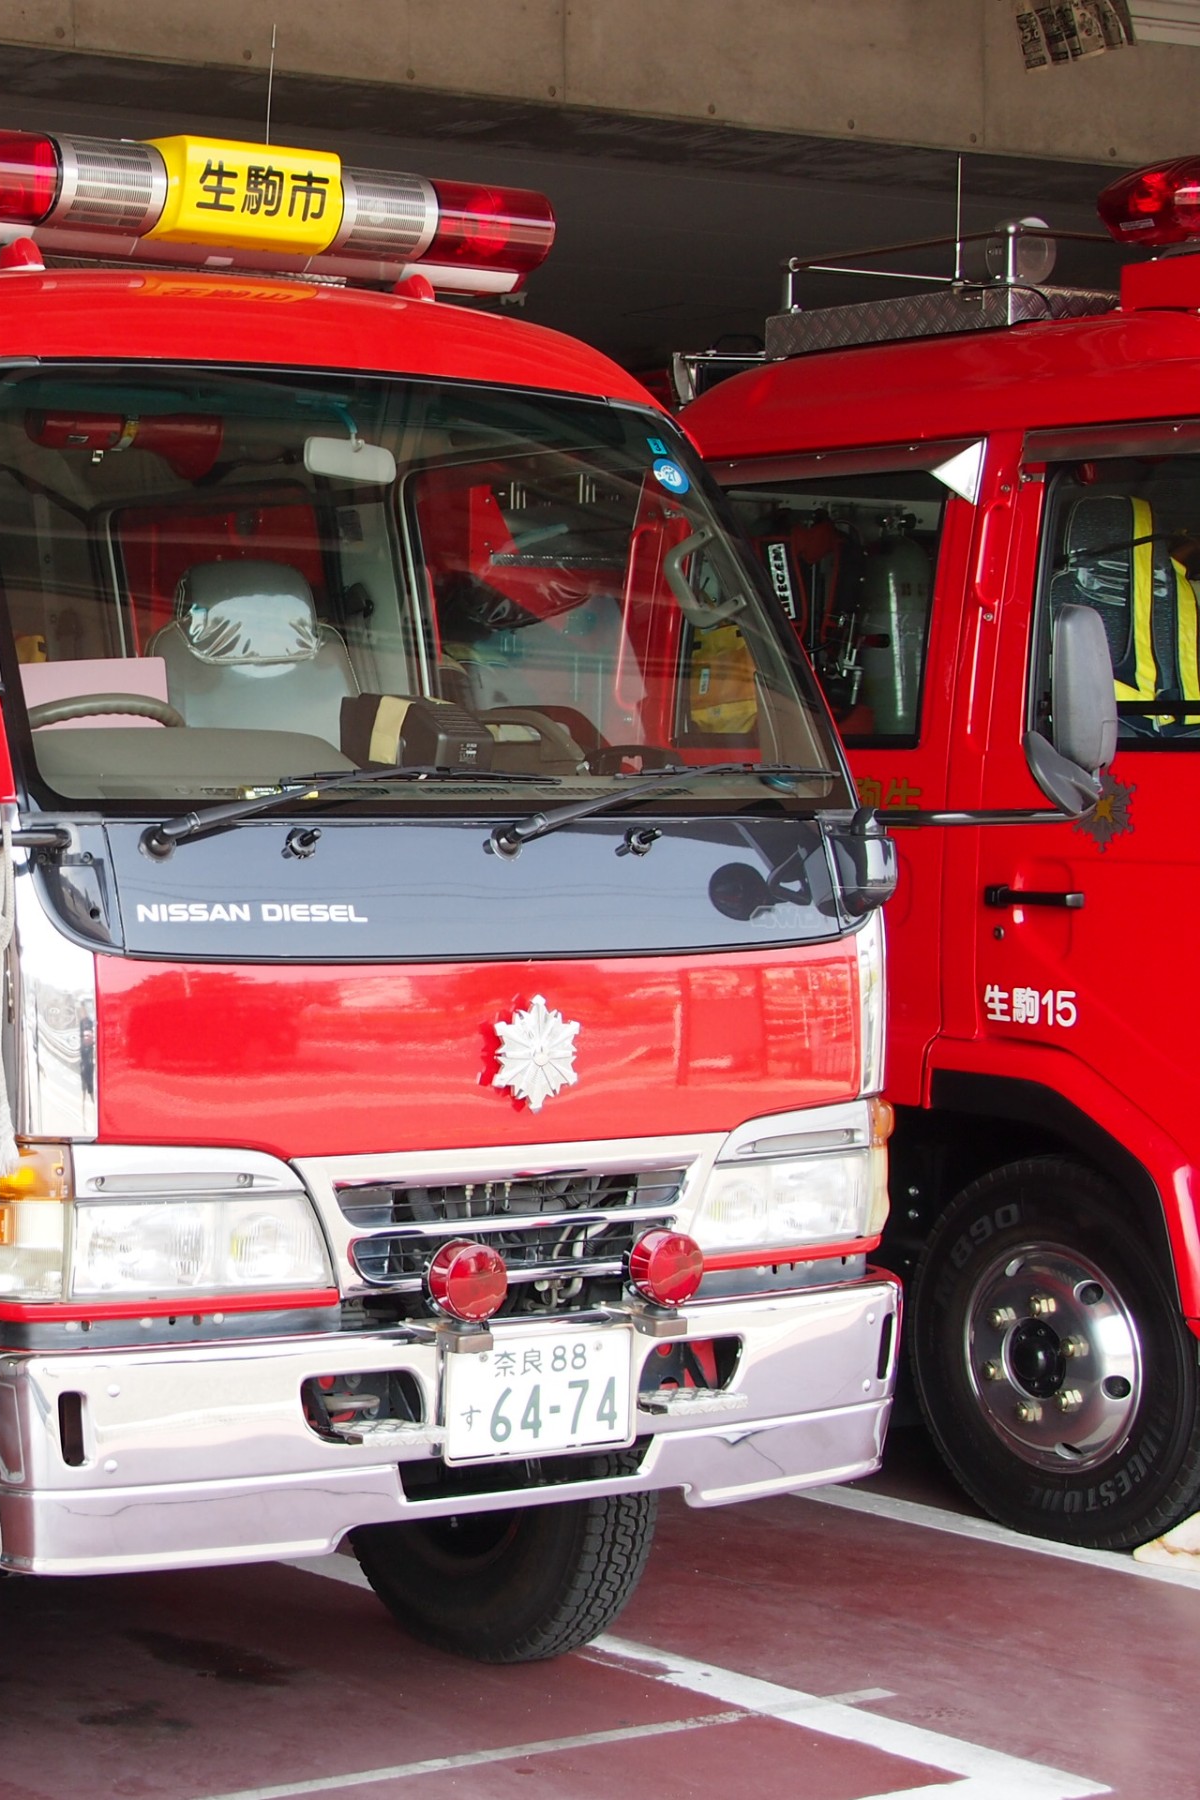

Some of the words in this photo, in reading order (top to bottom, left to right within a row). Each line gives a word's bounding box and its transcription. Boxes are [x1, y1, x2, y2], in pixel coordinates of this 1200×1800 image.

[196, 159, 329, 222] 生駒市
[136, 903, 250, 922] NISSAN
[261, 903, 368, 922] DIESEL
[984, 984, 1077, 1027] 生駒15
[494, 1349, 543, 1377] 奈良
[551, 1343, 587, 1372] 88
[460, 1404, 482, 1432] す
[490, 1376, 618, 1442] 64-74
[1026, 1382, 1172, 1513] RIDGESTONE
